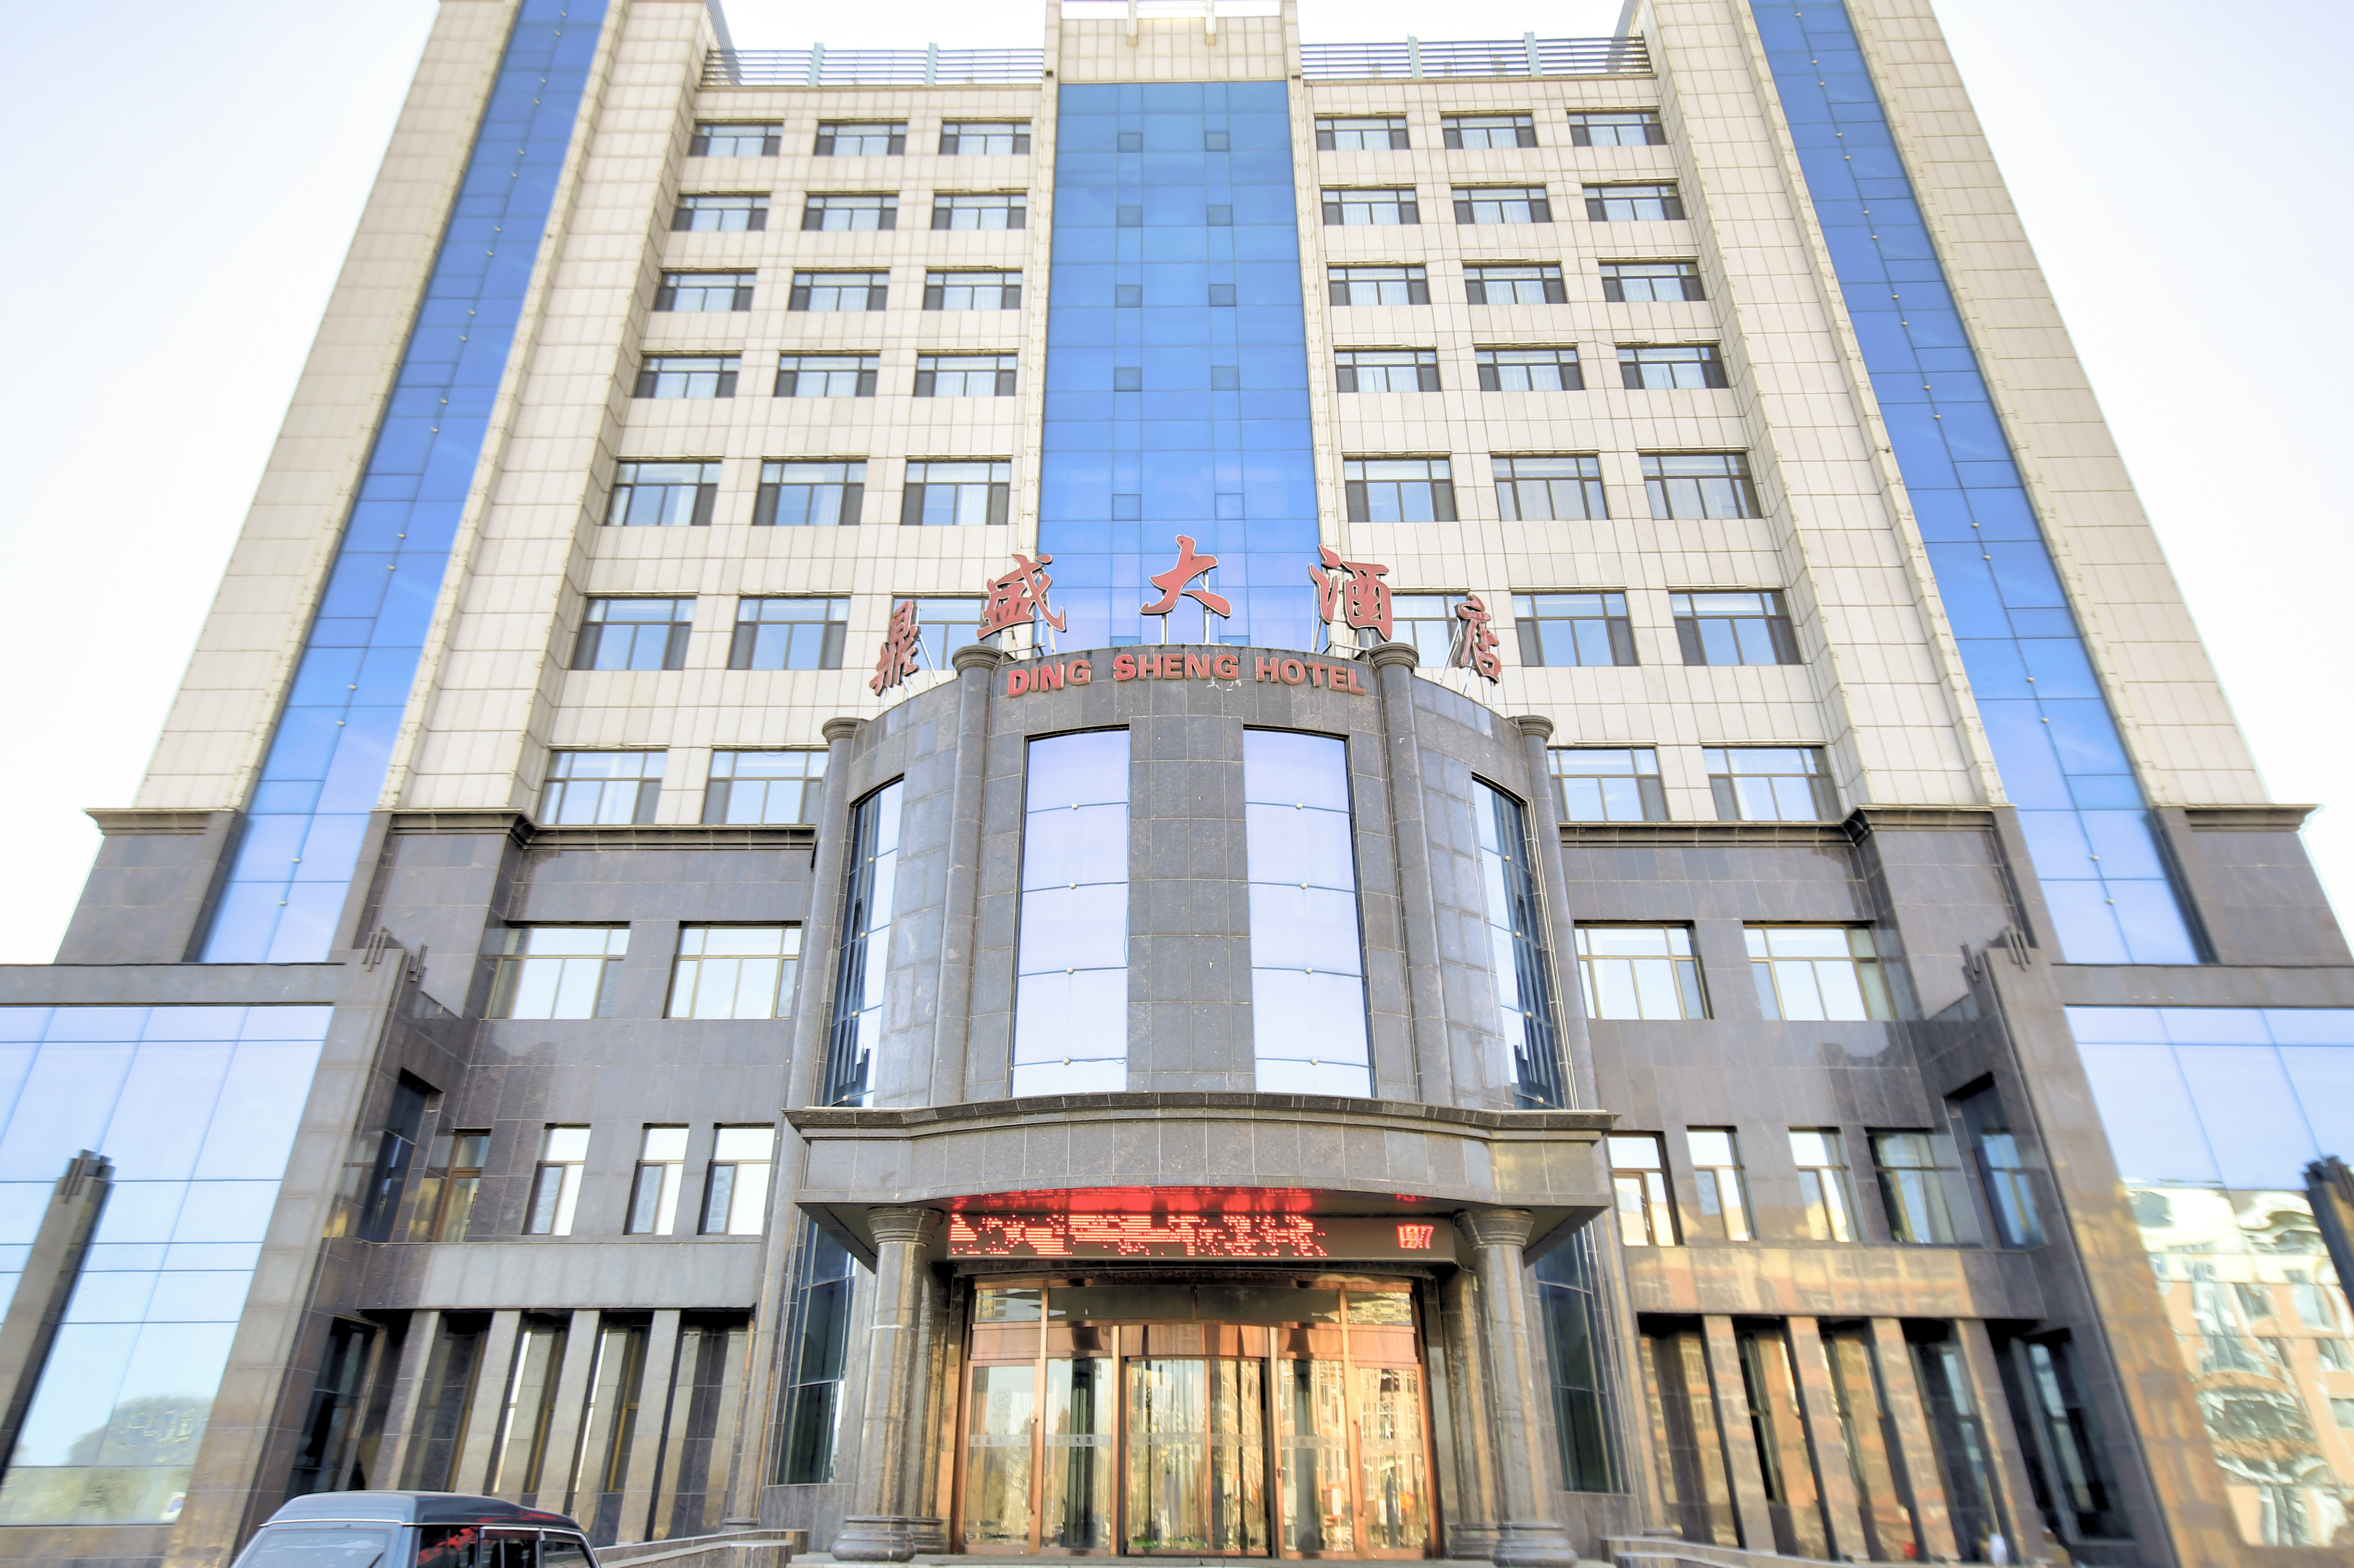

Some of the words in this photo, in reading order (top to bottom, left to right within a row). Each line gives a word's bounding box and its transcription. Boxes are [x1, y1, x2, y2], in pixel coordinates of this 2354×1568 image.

[870, 535, 1502, 696] 鼎盛大酒店
[1008, 659, 1091, 697] DING
[1113, 654, 1238, 682] SHENG
[1256, 656, 1366, 695] HOTEL
